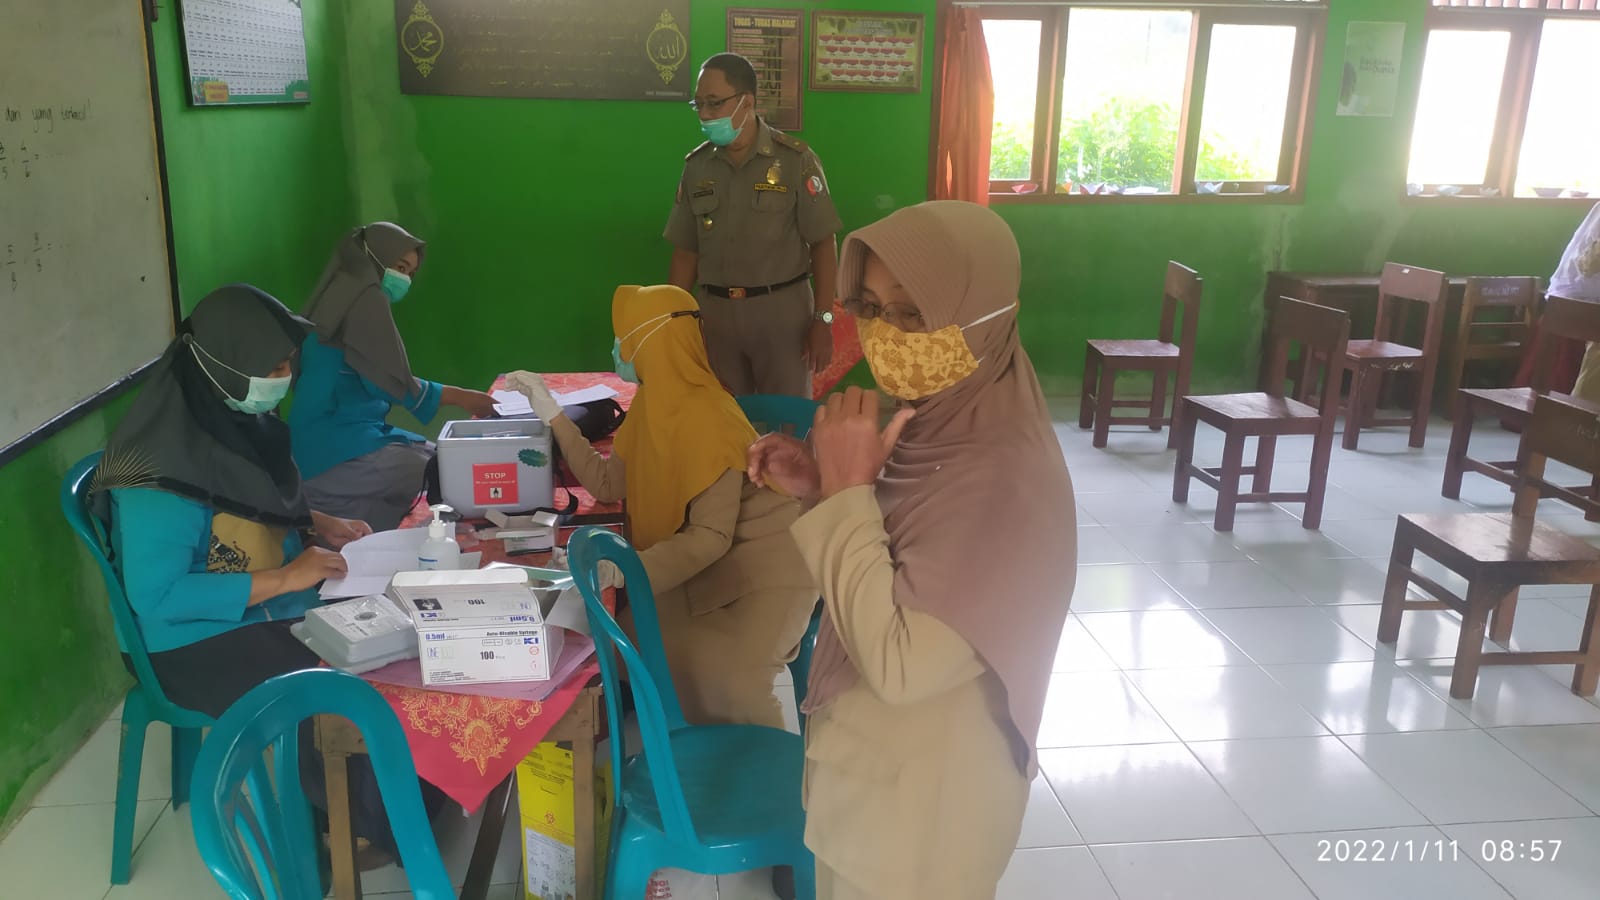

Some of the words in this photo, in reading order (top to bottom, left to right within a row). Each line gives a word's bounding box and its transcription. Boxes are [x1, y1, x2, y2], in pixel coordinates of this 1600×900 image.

[32, 107, 54, 134] yang
[425, 632, 445, 640] 0.5ml
[480, 651, 495, 660] 100
